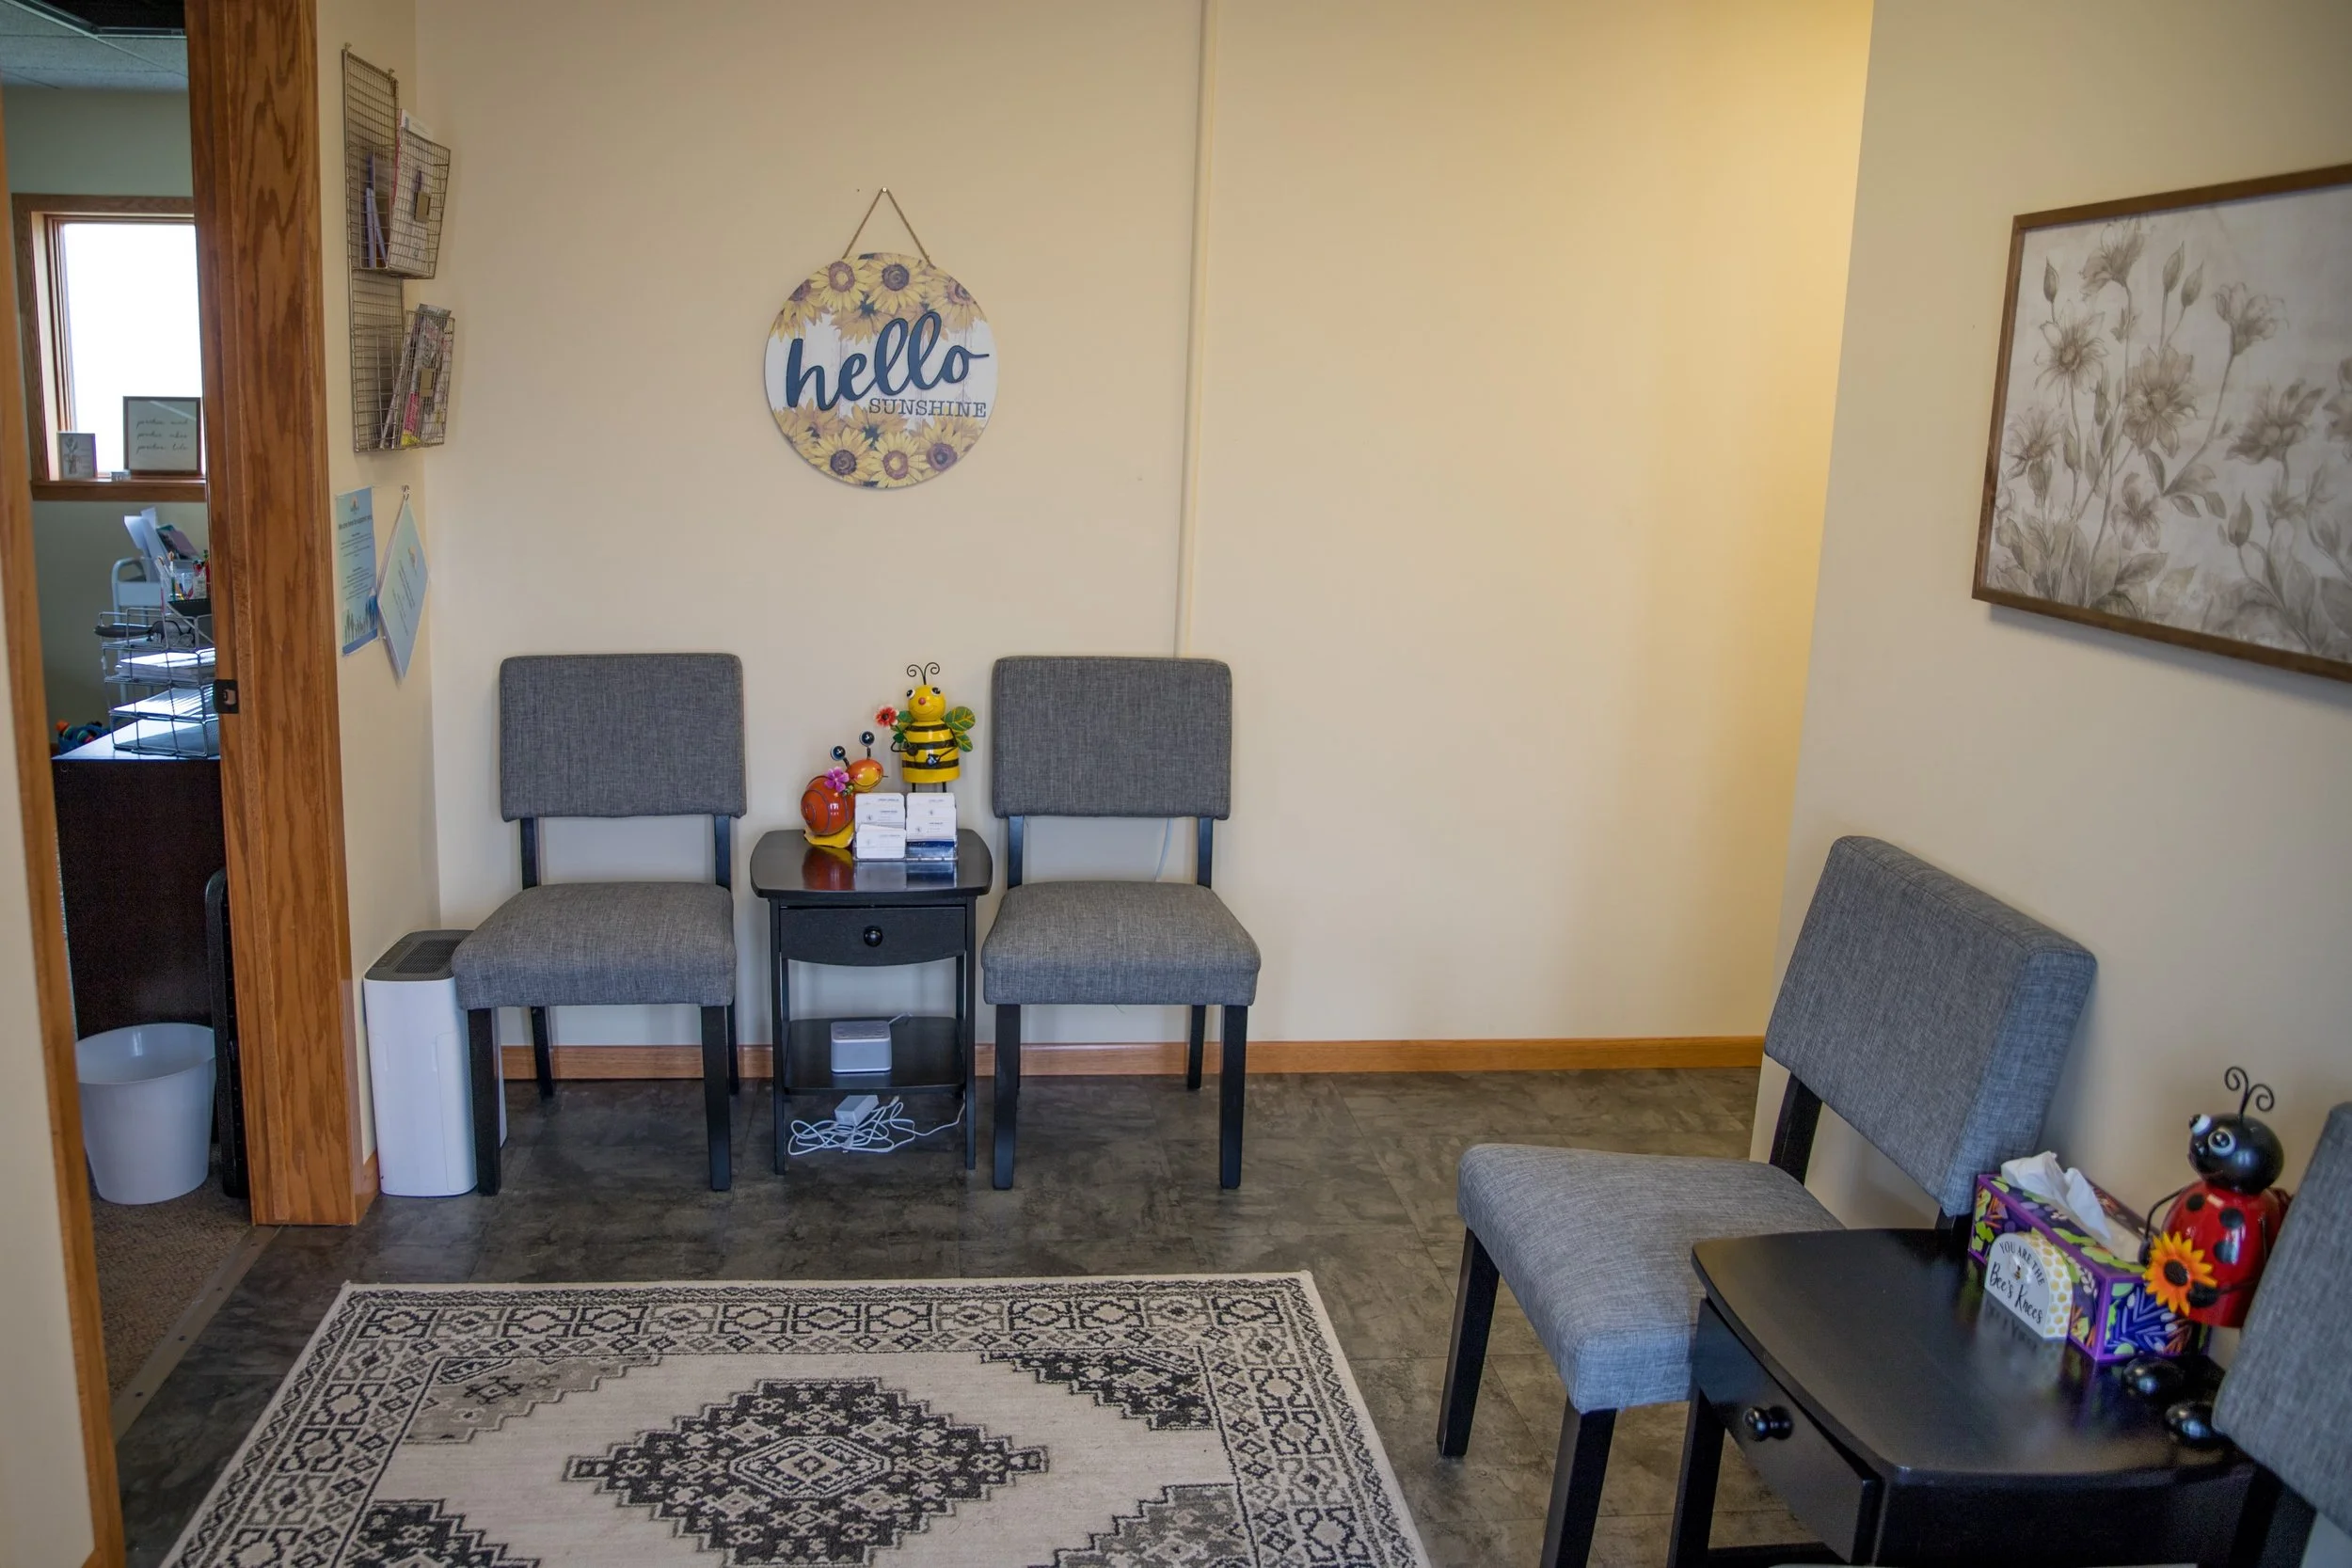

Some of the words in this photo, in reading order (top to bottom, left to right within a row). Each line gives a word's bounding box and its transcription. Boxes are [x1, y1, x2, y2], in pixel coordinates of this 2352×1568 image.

[786, 311, 990, 411] hello
[868, 398, 987, 418] SUNSHINE
[1999, 1242, 2015, 1254] YOU
[2018, 1245, 2032, 1264] ARE
[2031, 1260, 2045, 1287] THE
[1990, 1261, 2013, 1298] Bee's
[2014, 1284, 2043, 1324] Knees
